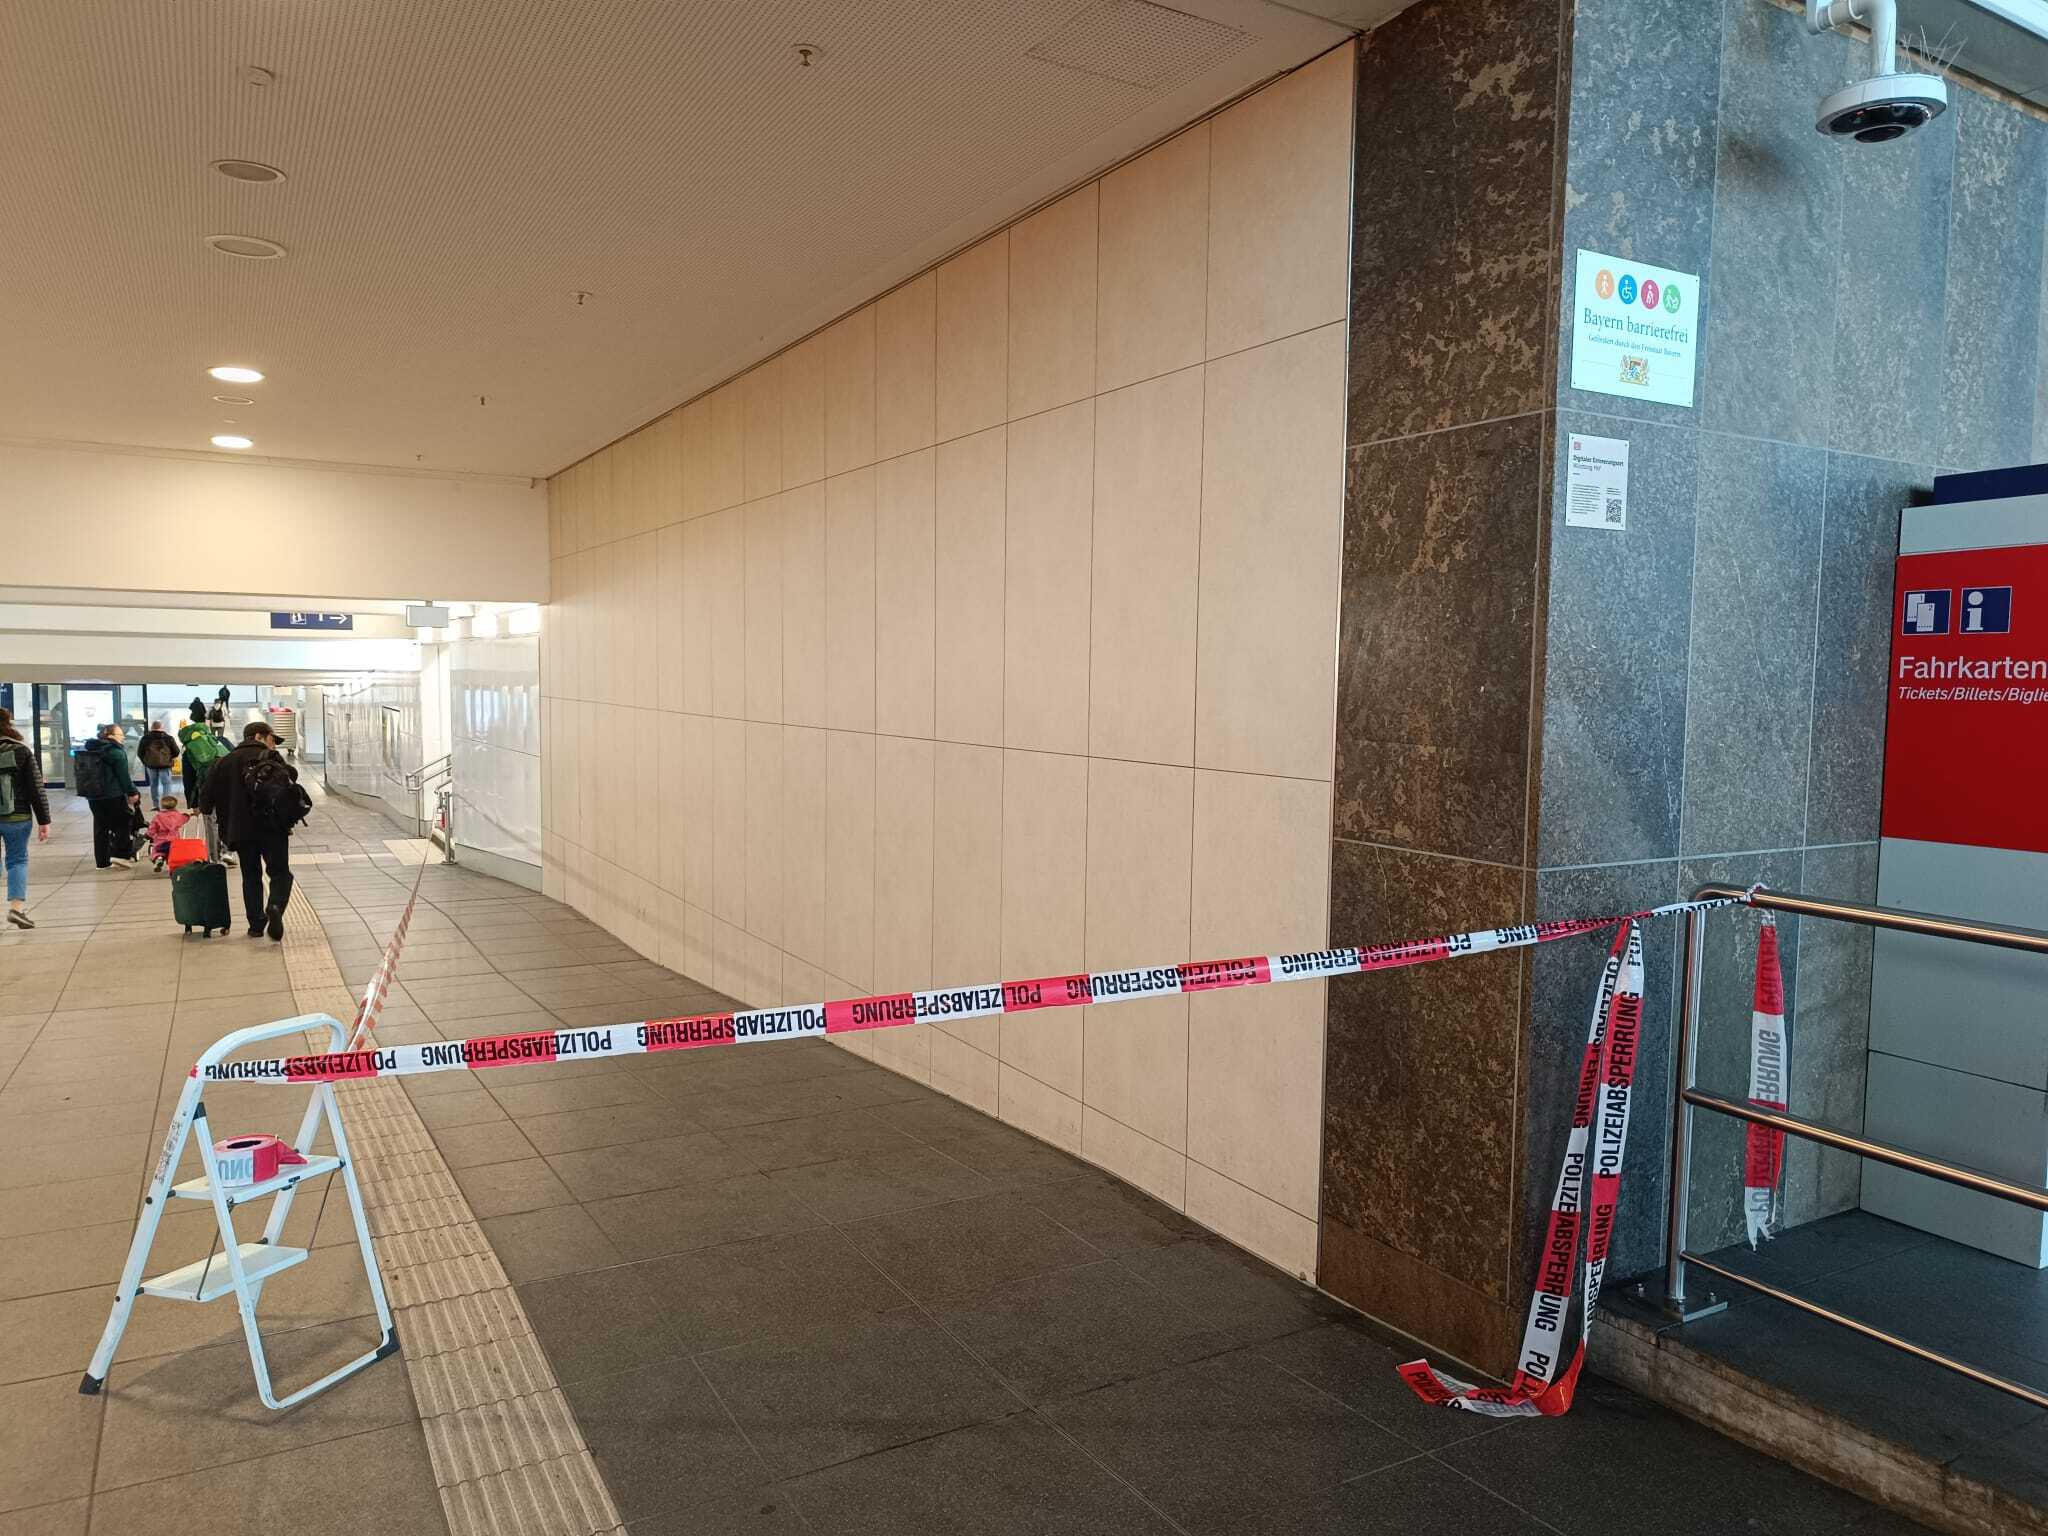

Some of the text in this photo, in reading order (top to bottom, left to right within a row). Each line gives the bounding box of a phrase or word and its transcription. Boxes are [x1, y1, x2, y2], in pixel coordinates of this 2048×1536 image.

[1583, 307, 1689, 343] Bayern barrierefrei
[1898, 655, 2048, 680] Fahrkarten
[1066, 956, 1257, 999] POLIZEIABSPERRUNG
[851, 984, 1041, 1024] POLIZEIABSPERRUNG
[638, 1004, 827, 1048] POLIZEIABSPERRUNG
[421, 1030, 612, 1067] POLIZEIABSPERRUNG
[1598, 991, 1640, 1179] POLIZEIABSPERRUNG
[1534, 1152, 1584, 1333] POLIZEIABSPERRUNG
